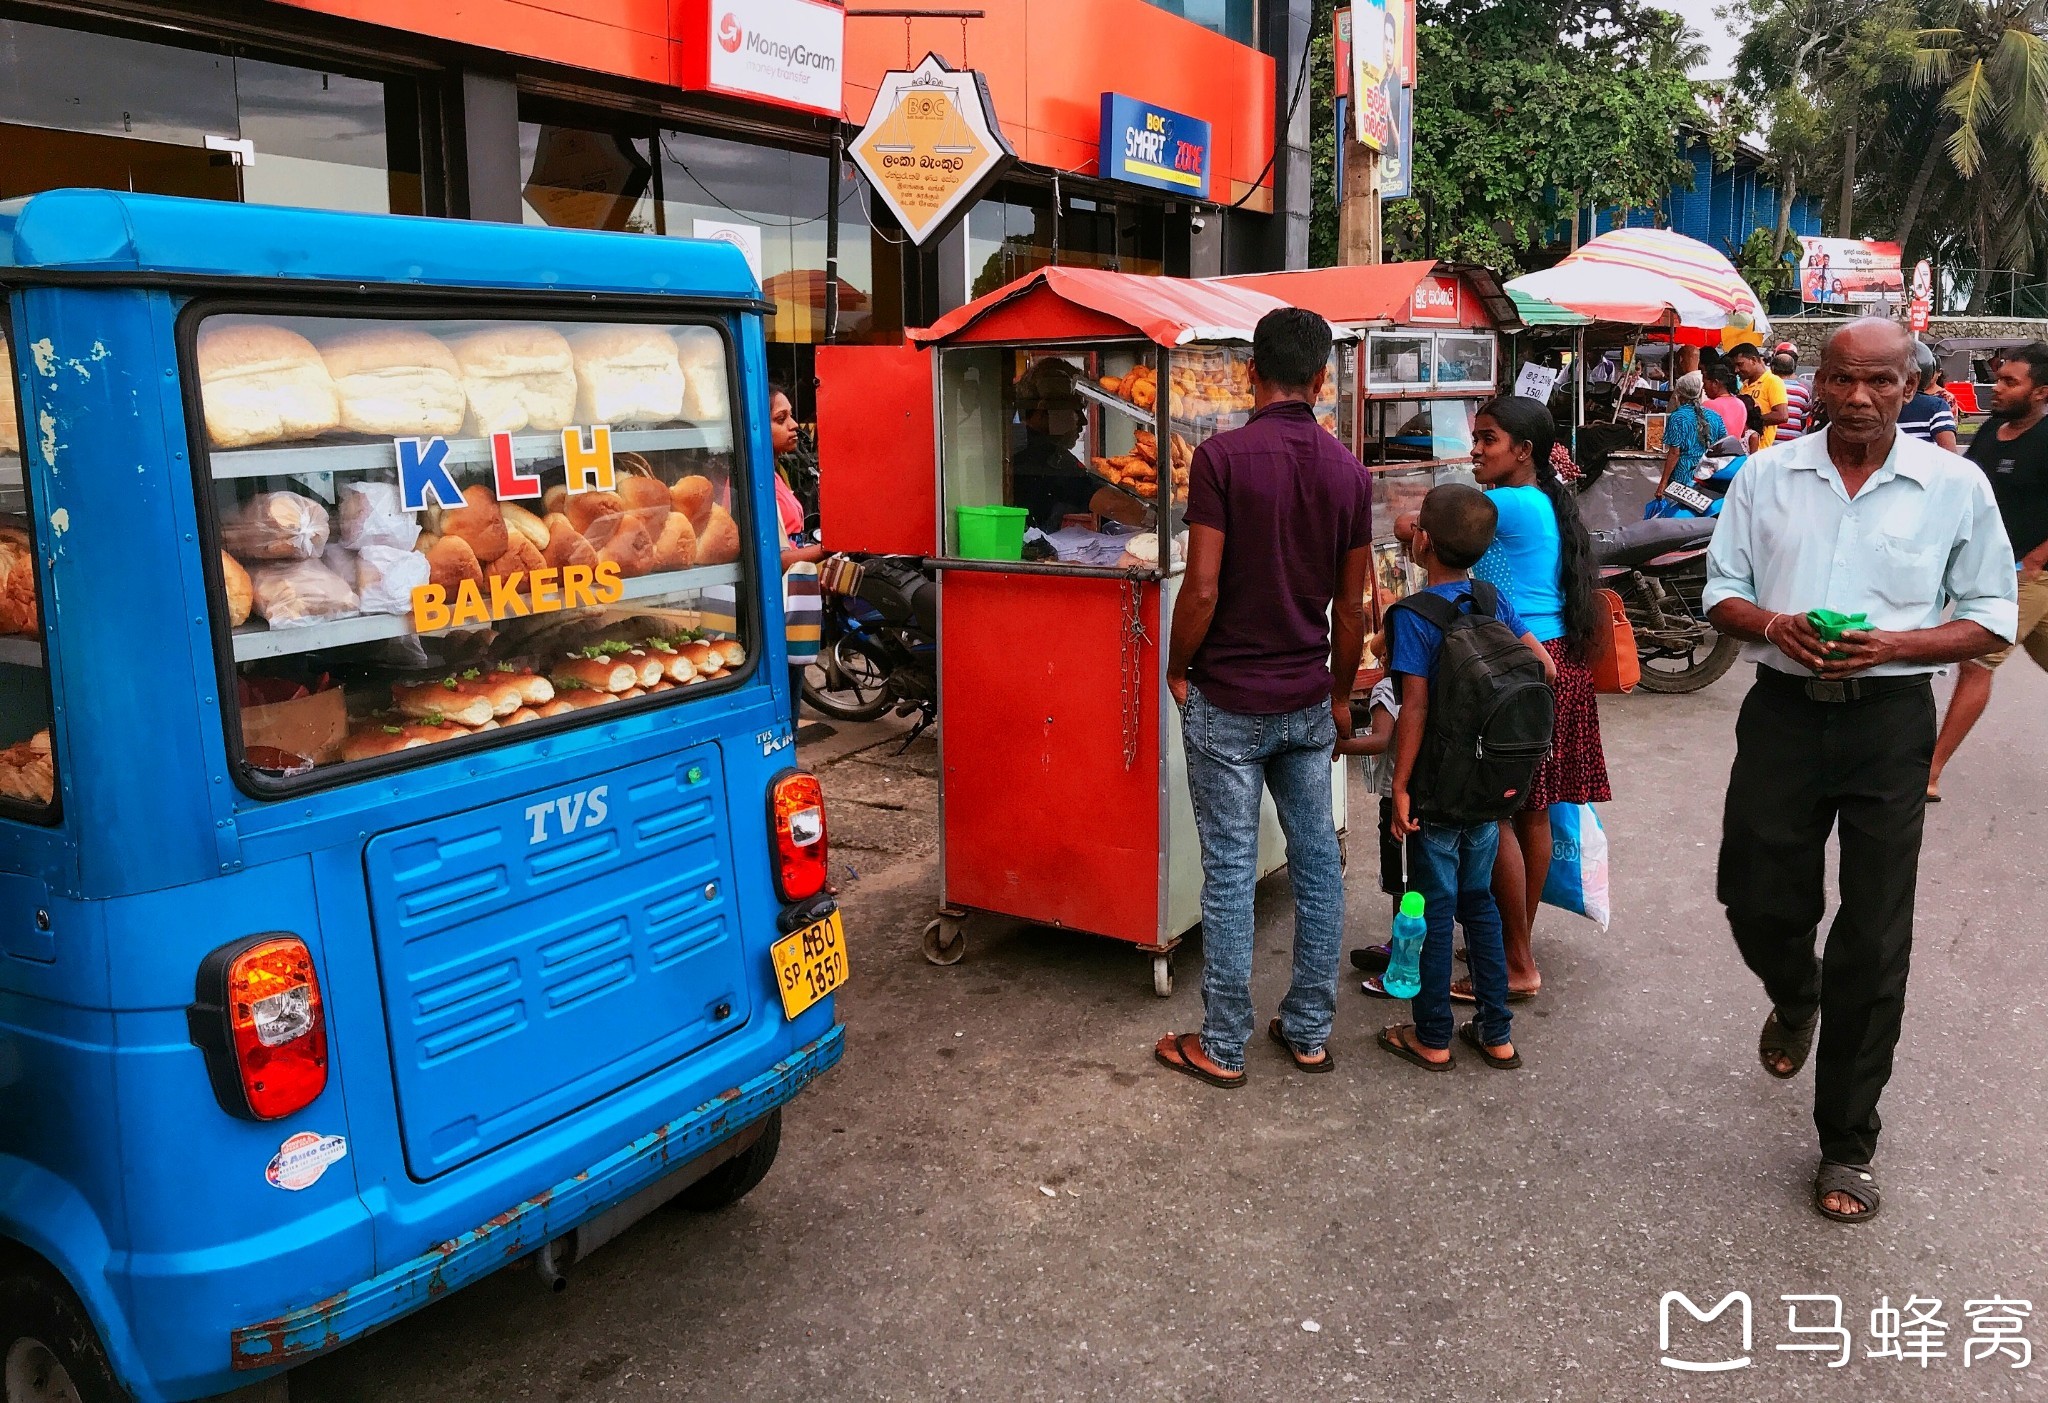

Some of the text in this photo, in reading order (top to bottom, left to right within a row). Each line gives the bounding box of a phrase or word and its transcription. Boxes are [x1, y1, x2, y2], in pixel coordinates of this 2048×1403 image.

[746, 31, 836, 72] MoneyGram
[746, 61, 811, 84] money transfer
[908, 97, 945, 117] BOC
[1146, 112, 1166, 134] BOC
[1125, 126, 1203, 174] SMART ZONE
[882, 154, 964, 173] ලංකා බැංකුව
[411, 560, 624, 634] BAKERS
[755, 729, 773, 745] TVS
[525, 785, 608, 845] TVS
[783, 962, 801, 991] SP
[290, 1148, 317, 1165] Auto
